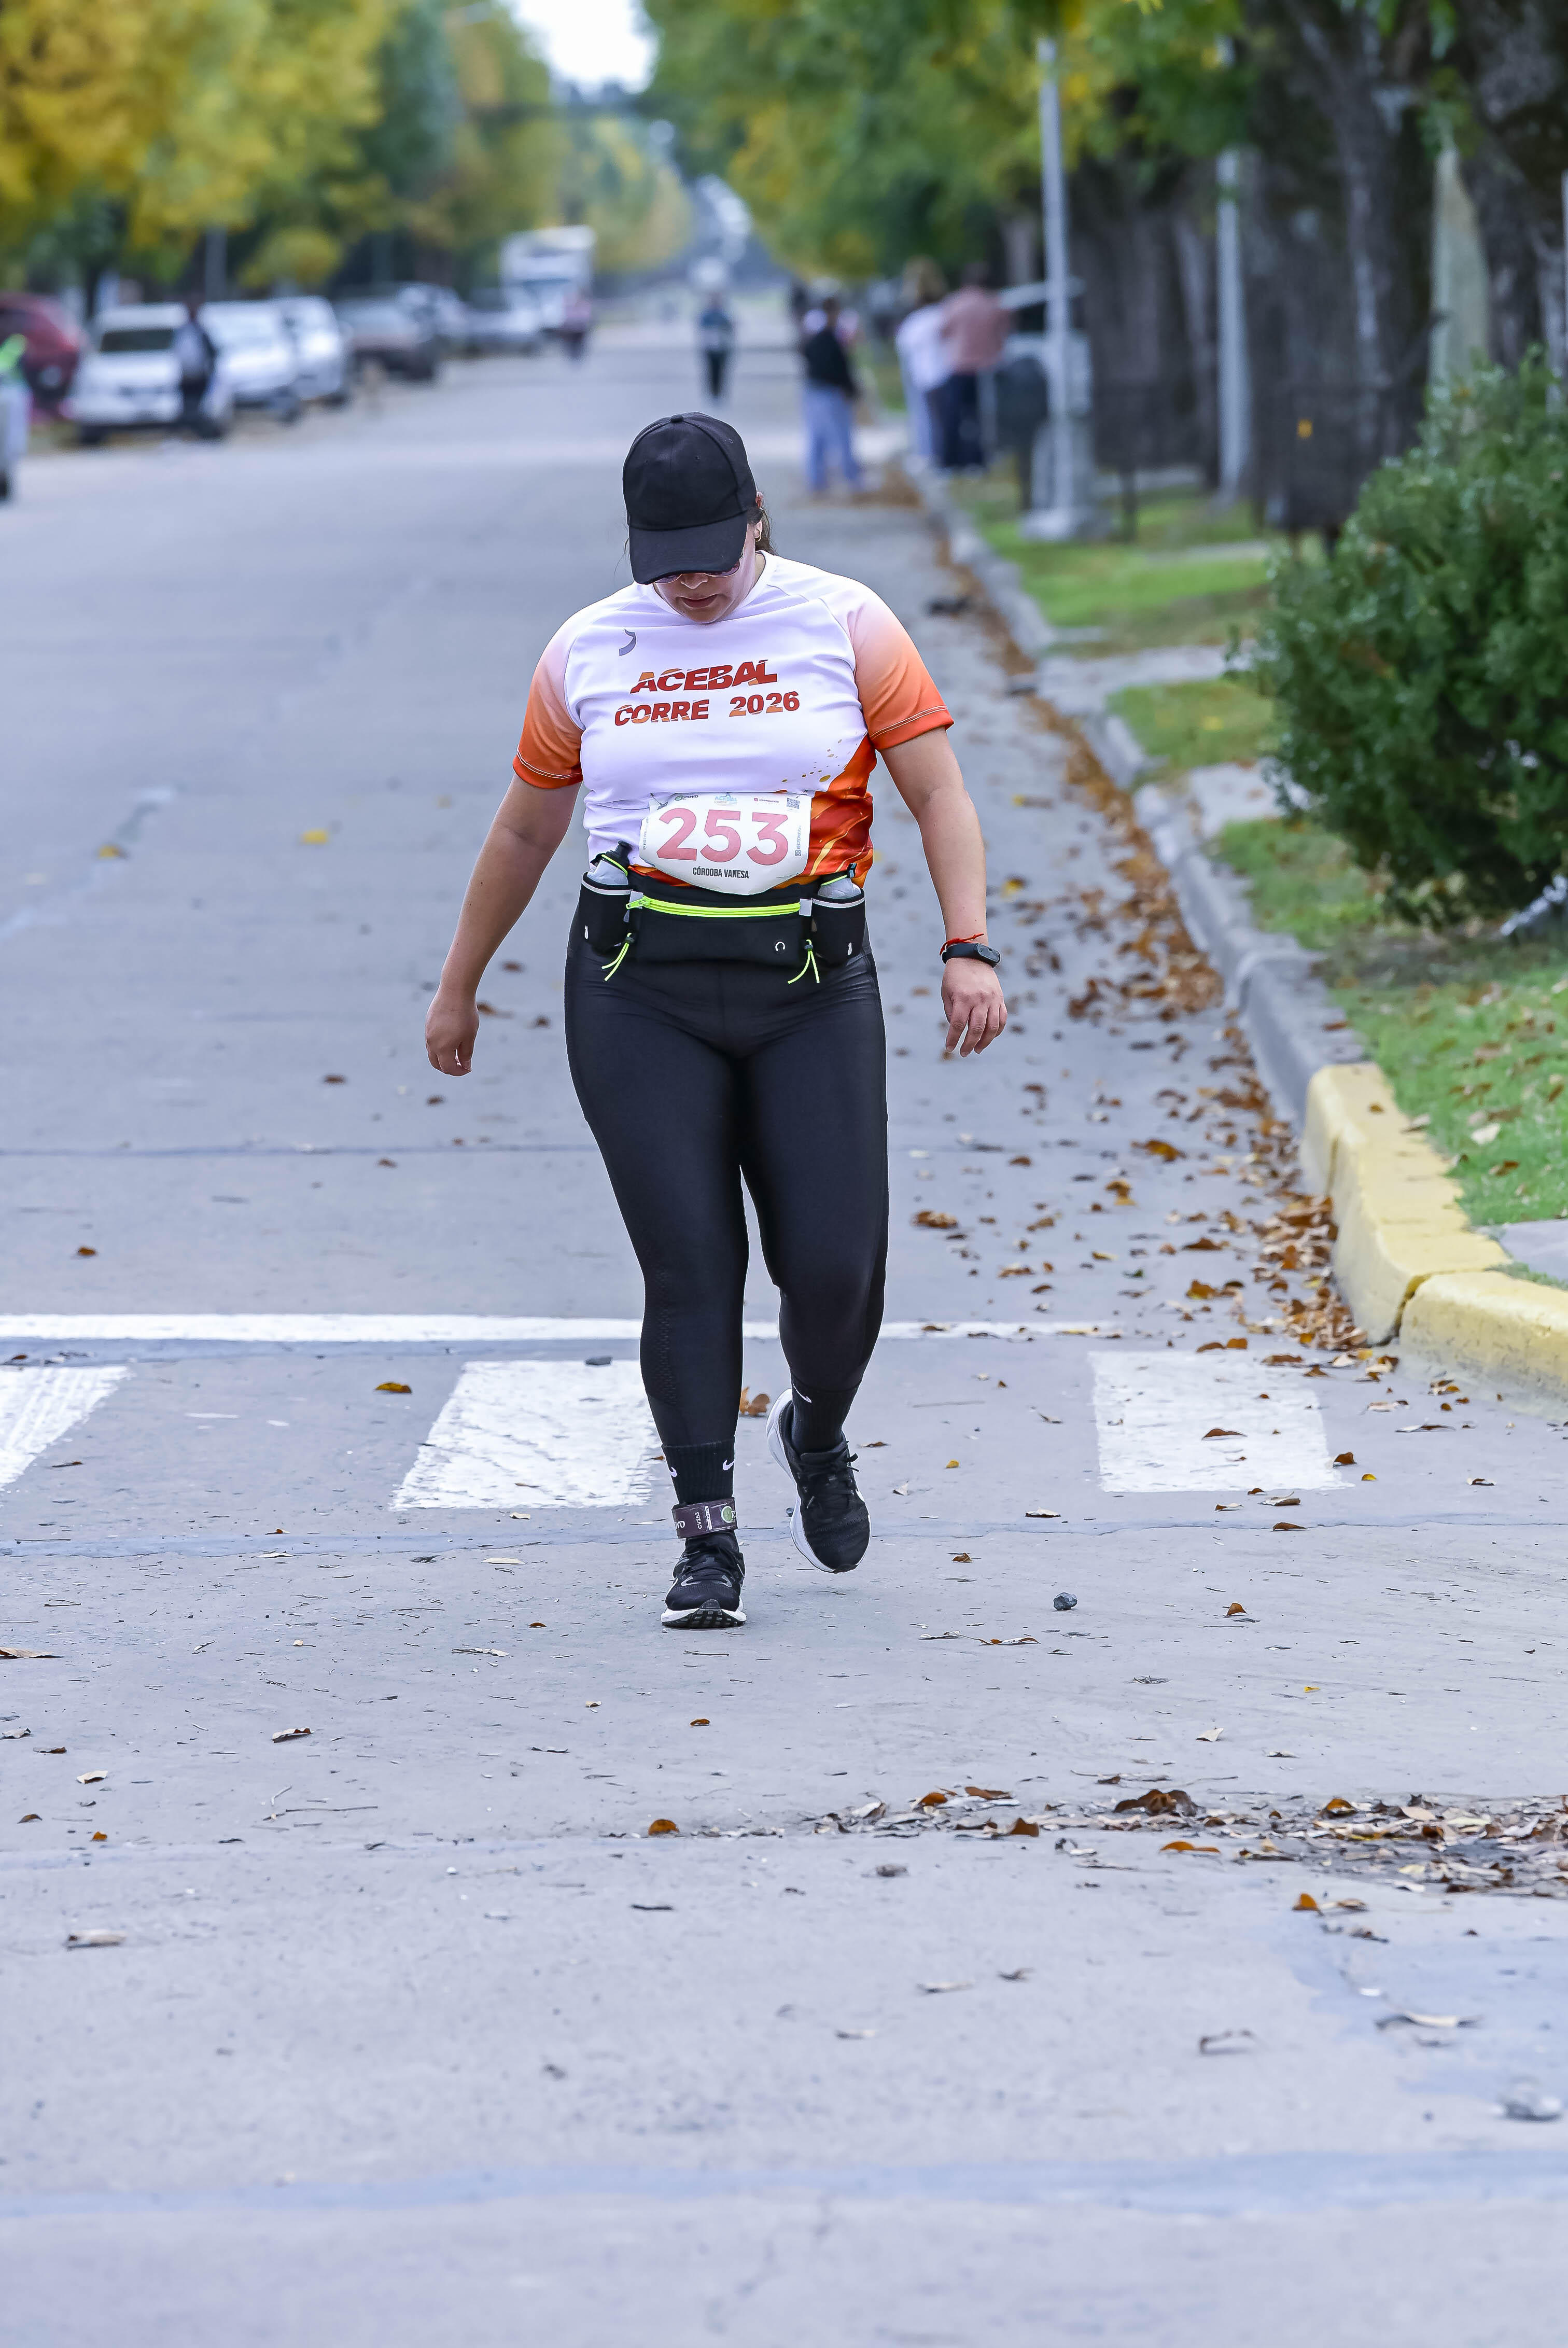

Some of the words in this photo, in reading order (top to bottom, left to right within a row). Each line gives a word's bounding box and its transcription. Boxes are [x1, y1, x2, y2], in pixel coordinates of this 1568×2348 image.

[629, 660, 777, 693] ACEBAL
[615, 700, 709, 726] CORRE
[729, 691, 799, 717] 2026
[656, 808, 788, 865] 253
[692, 866, 722, 877] CÓRDOBA
[724, 869, 749, 878] VANESA
